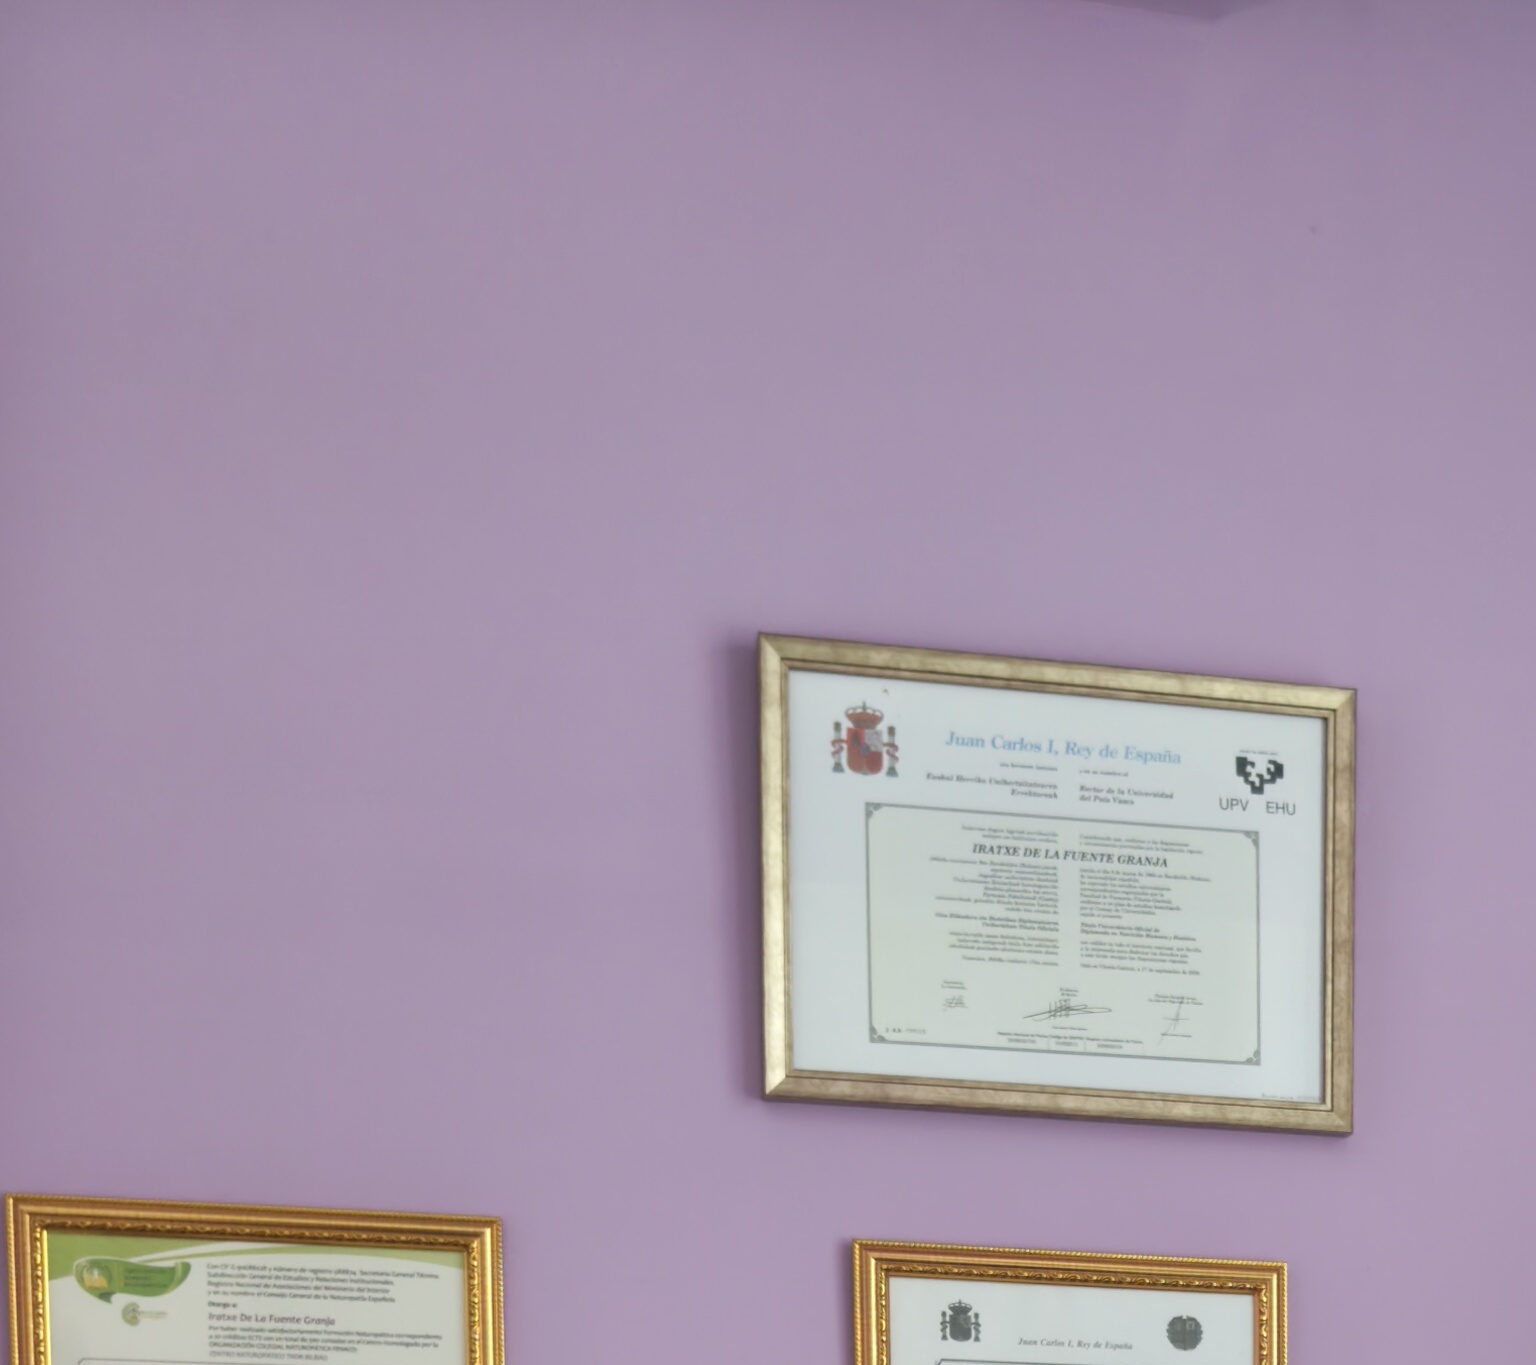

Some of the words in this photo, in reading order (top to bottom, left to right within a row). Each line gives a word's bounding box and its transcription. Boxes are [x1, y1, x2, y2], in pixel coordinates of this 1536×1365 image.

[945, 731, 985, 748] Juan
[991, 734, 1042, 753] Carlos
[1064, 741, 1093, 759] Rey
[1099, 744, 1118, 759] de
[1123, 747, 1181, 765] España
[1219, 798, 1249, 811] UPV
[1266, 801, 1296, 815] EHU
[973, 843, 1020, 857] IRATXE
[1023, 847, 1041, 858] DE
[1045, 849, 1060, 860] LA
[1064, 850, 1115, 864] FUENTE
[1117, 854, 1168, 868] GRANJA
[208, 1312, 237, 1321] Iratxe
[240, 1313, 252, 1322] De
[255, 1314, 266, 1323] La
[269, 1314, 301, 1324] Fuente
[304, 1316, 335, 1326] Granja
[1018, 1338, 1038, 1346] Juan
[1040, 1338, 1065, 1348] Carlos
[1077, 1340, 1091, 1350] Rey
[1093, 1340, 1102, 1349] de
[1105, 1341, 1133, 1351] España
